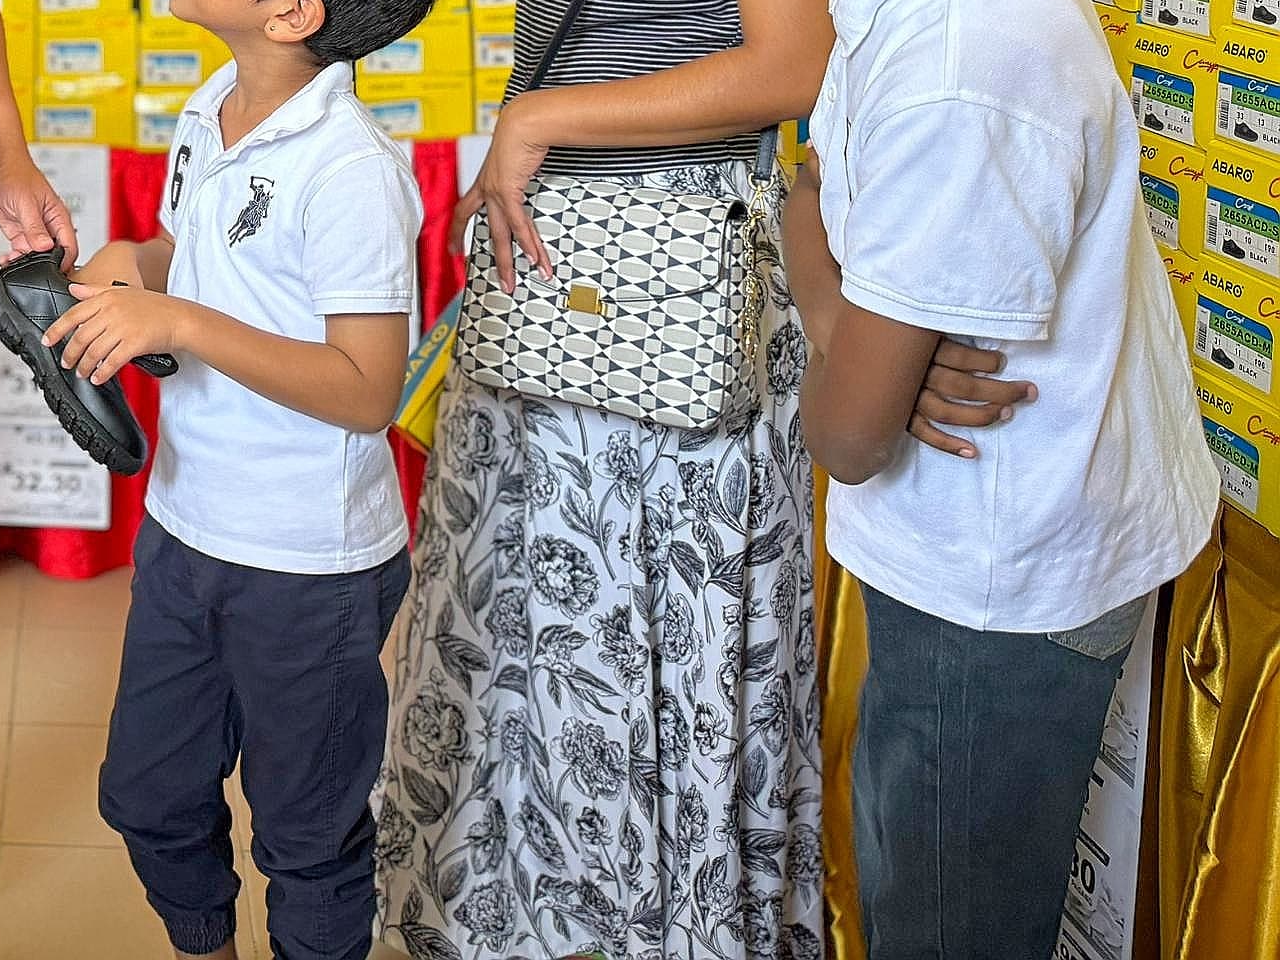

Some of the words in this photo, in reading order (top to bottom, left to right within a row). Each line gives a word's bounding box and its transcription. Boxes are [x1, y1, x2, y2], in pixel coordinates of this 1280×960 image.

[1182, 16, 1199, 26] BLACK
[1135, 38, 1169, 57] ABARO
[1223, 40, 1265, 63] ABARO
[1146, 85, 1193, 107] 2655ACD-S
[1167, 123, 1183, 134] BLACK
[1212, 158, 1253, 183] ABARO
[1224, 209, 1279, 237] 2655ACD-S
[1249, 251, 1268, 265] BLACK
[1203, 270, 1242, 298] ABARO
[1214, 316, 1271, 354] 2655ACD-M
[1238, 364, 1258, 379] BLACK
[1196, 386, 1232, 415] ABARO
[1227, 481, 1245, 498] BLACK
